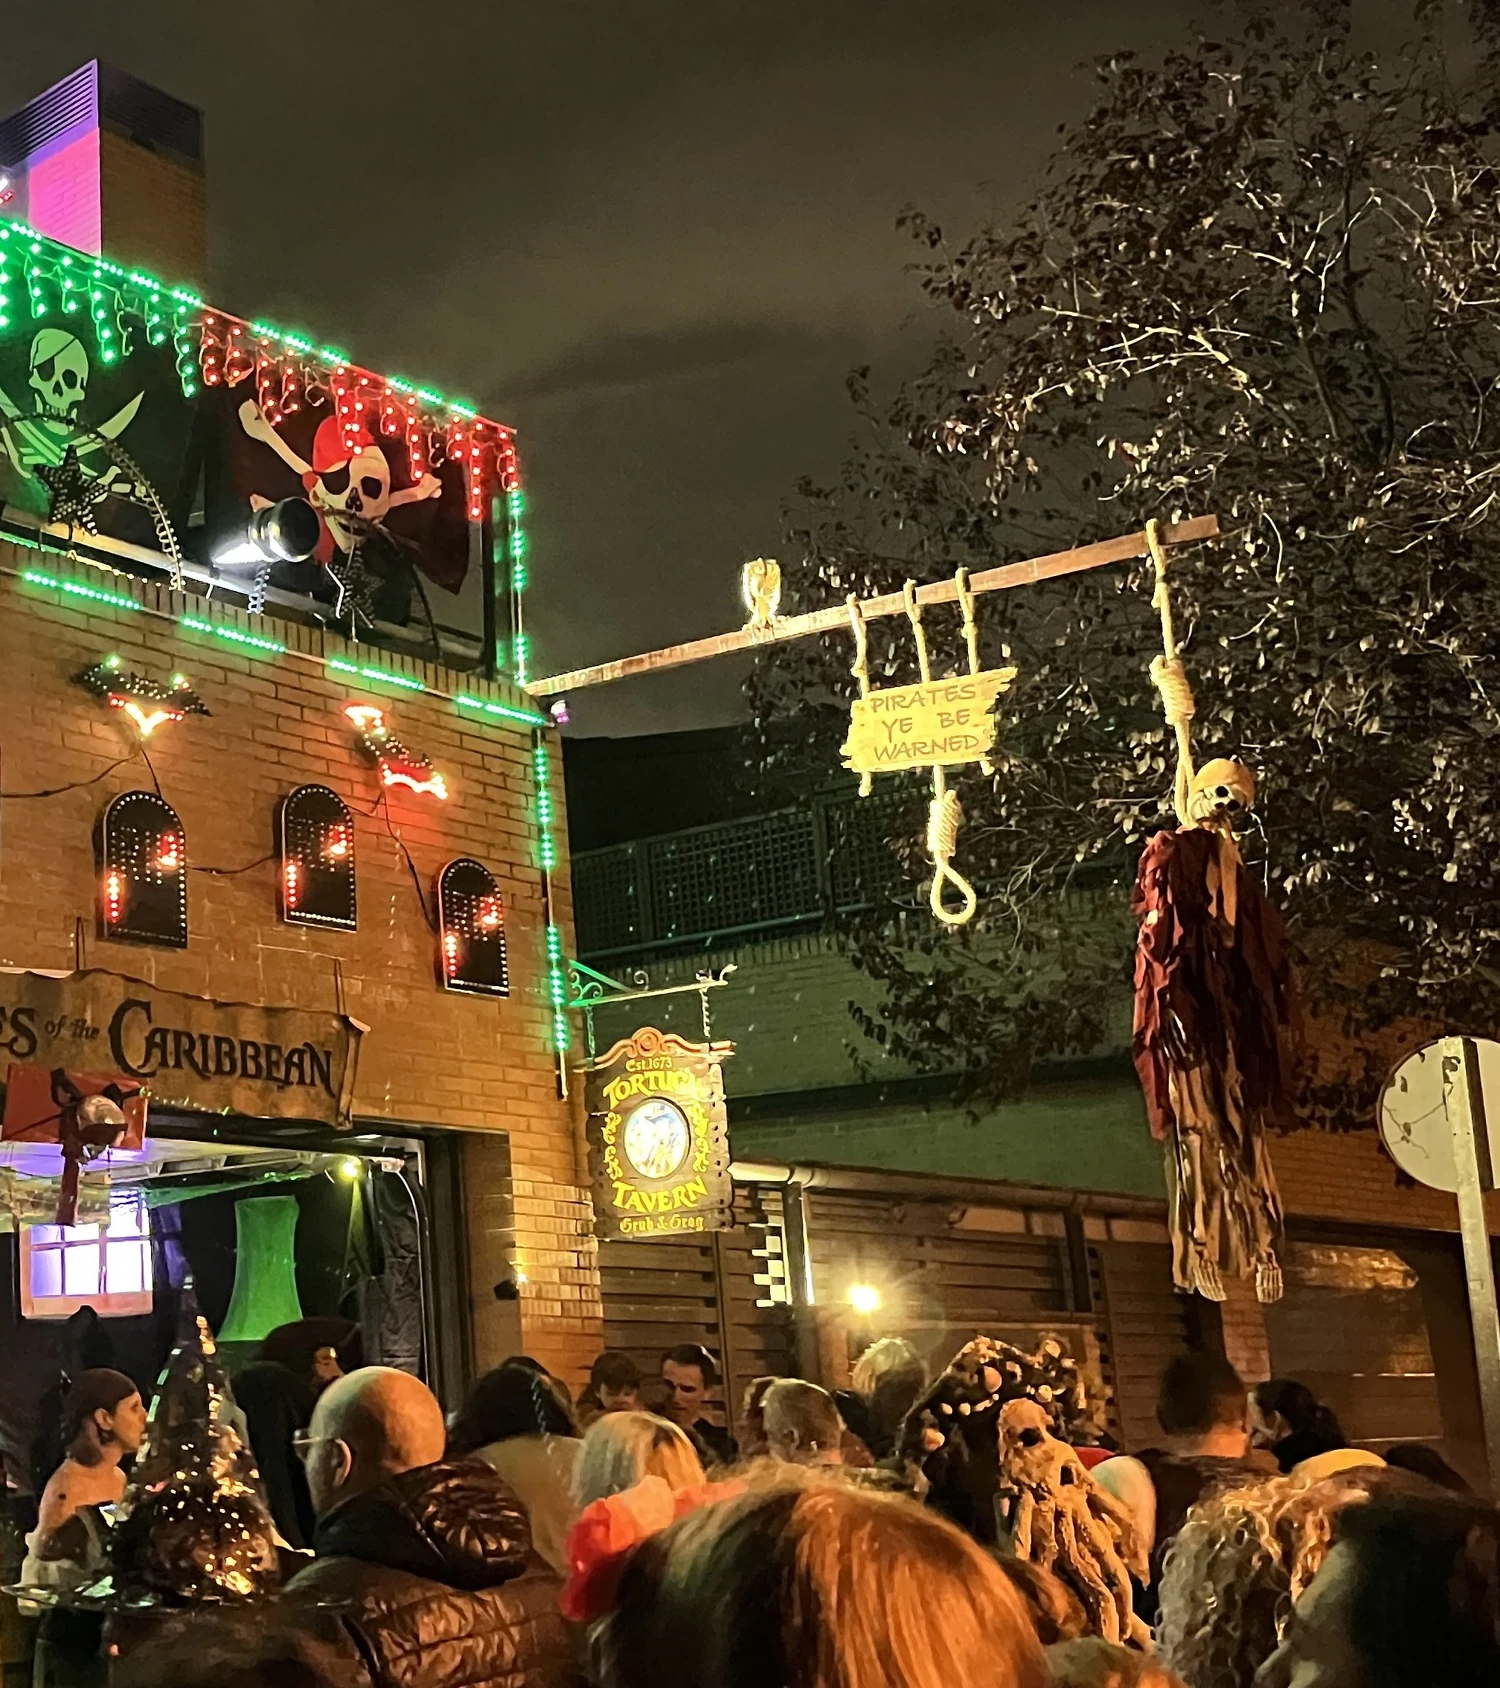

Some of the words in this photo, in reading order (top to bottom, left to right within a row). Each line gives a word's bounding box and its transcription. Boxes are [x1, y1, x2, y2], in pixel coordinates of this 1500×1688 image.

[871, 684, 976, 712] PIRATES
[882, 717, 913, 743] YE
[937, 709, 970, 729] BE
[874, 735, 979, 761] WARNED
[44, 1014, 68, 1039] of
[71, 1018, 100, 1040] the
[108, 998, 336, 1098] CARIBBEAN
[611, 1176, 708, 1213] TAVERN
[620, 1217, 654, 1233] Grub
[657, 1215, 668, 1230] &
[669, 1214, 704, 1231] Grog
